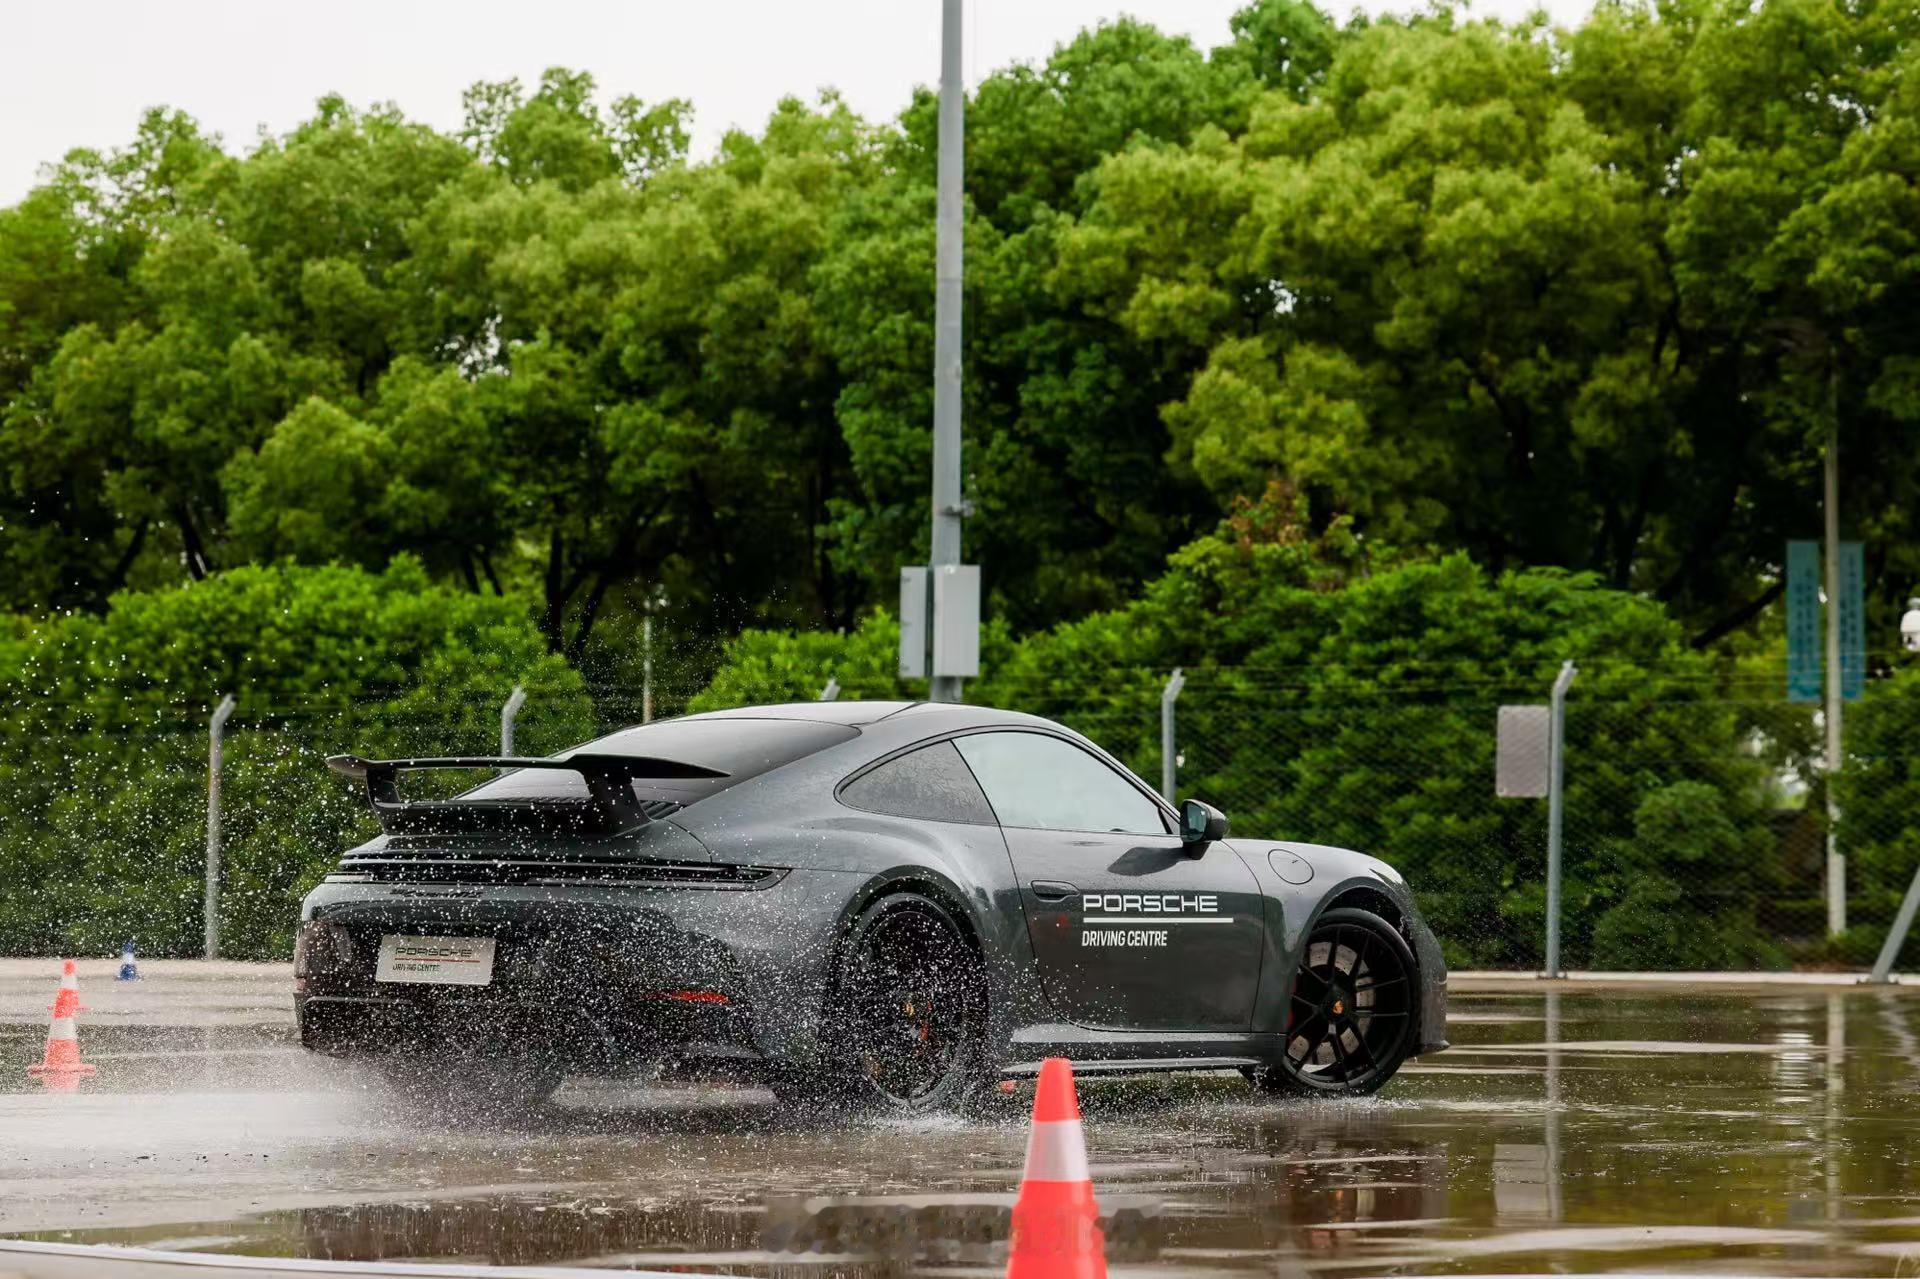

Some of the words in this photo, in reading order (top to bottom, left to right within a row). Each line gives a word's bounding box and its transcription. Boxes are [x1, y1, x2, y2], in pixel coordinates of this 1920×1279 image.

[1083, 894, 1218, 912] PORSCHE
[1081, 930, 1126, 947] DRIVING
[1127, 931, 1168, 947] CENTRE
[395, 947, 472, 957] PORSCHE
